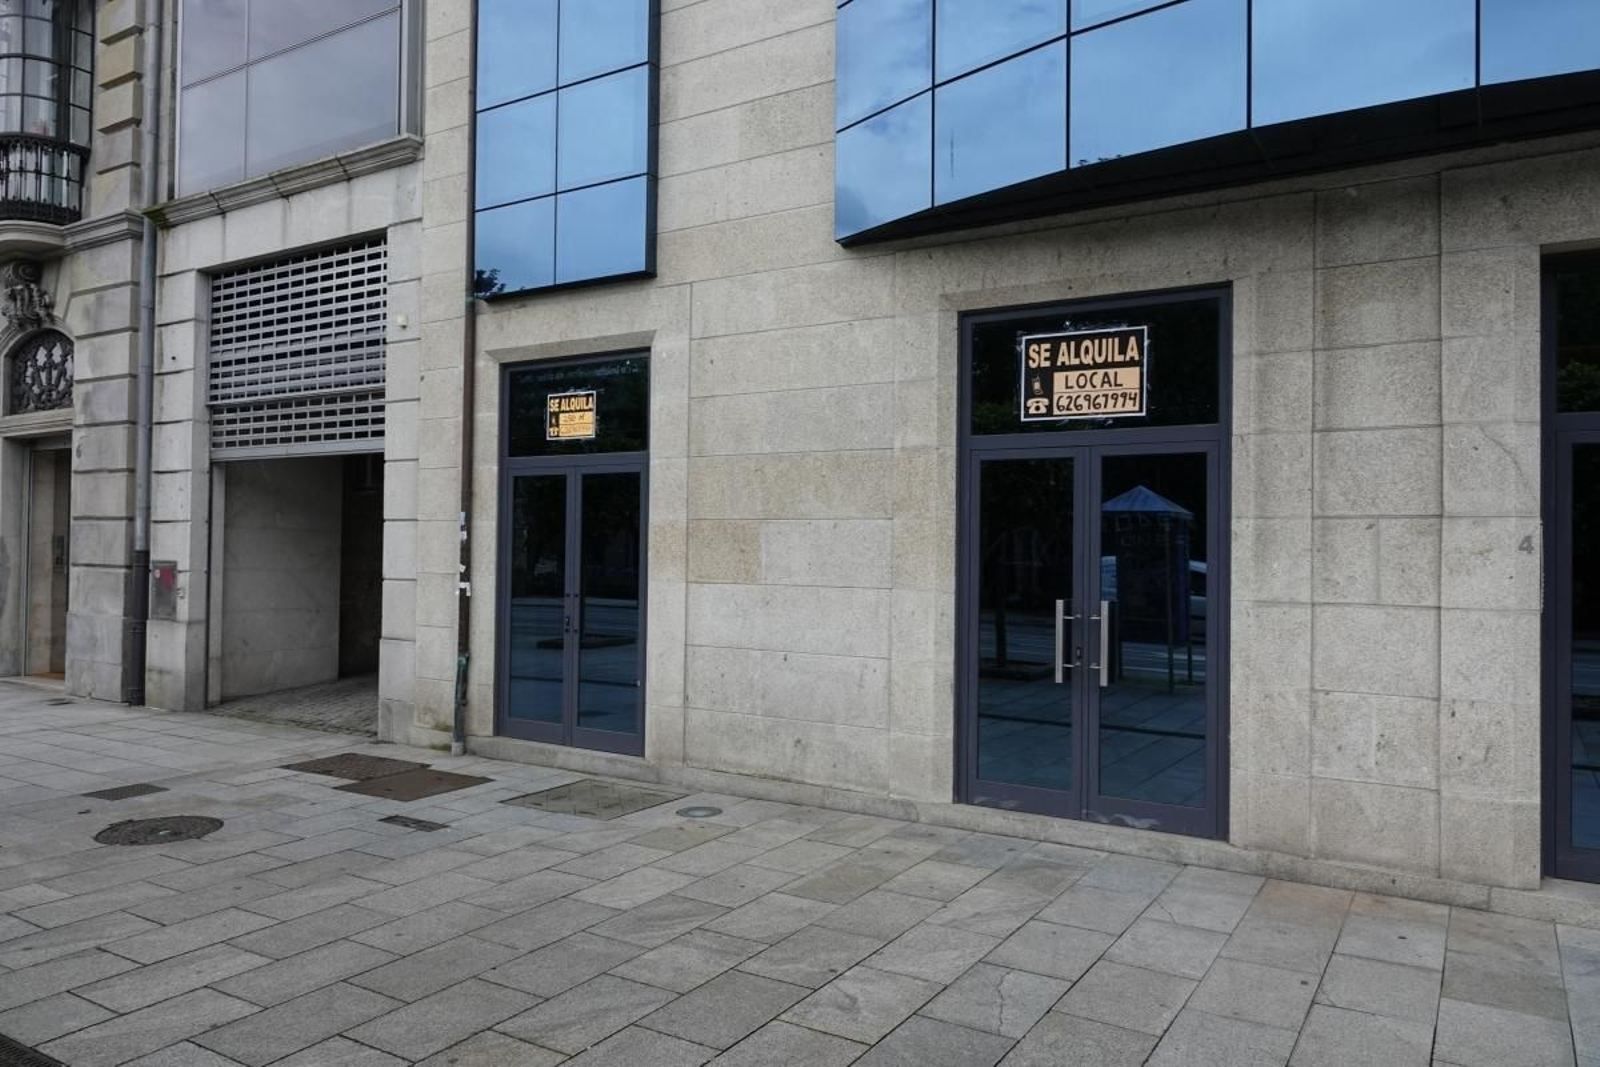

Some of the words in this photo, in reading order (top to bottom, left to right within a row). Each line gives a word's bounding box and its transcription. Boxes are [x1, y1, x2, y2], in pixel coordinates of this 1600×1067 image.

[1028, 343, 1051, 368] SE
[1056, 336, 1139, 366] ALQUILA
[1064, 371, 1123, 390] LOCAL
[549, 398, 560, 412] SE
[560, 396, 593, 411] ALQUILA
[1056, 391, 1138, 412] 626967994
[1518, 535, 1535, 554] 4
